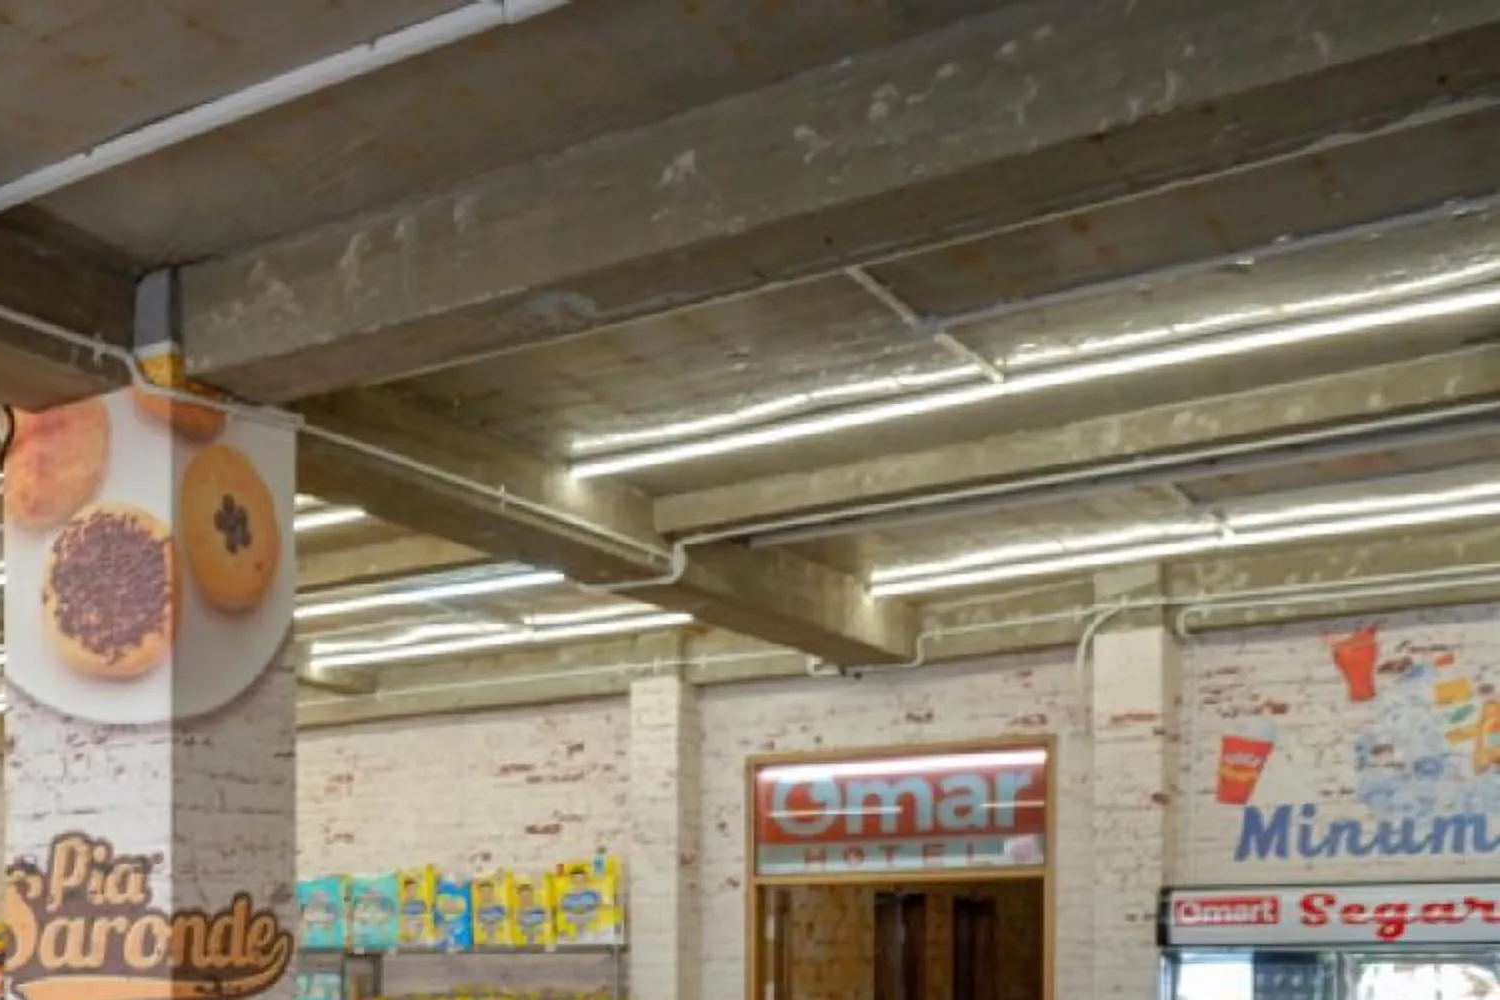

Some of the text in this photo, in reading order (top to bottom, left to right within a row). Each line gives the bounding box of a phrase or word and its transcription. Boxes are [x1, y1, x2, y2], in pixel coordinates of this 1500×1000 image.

[767, 768, 1033, 836] Omar
[46, 833, 150, 911] Pia
[1175, 898, 1279, 926] Omart
